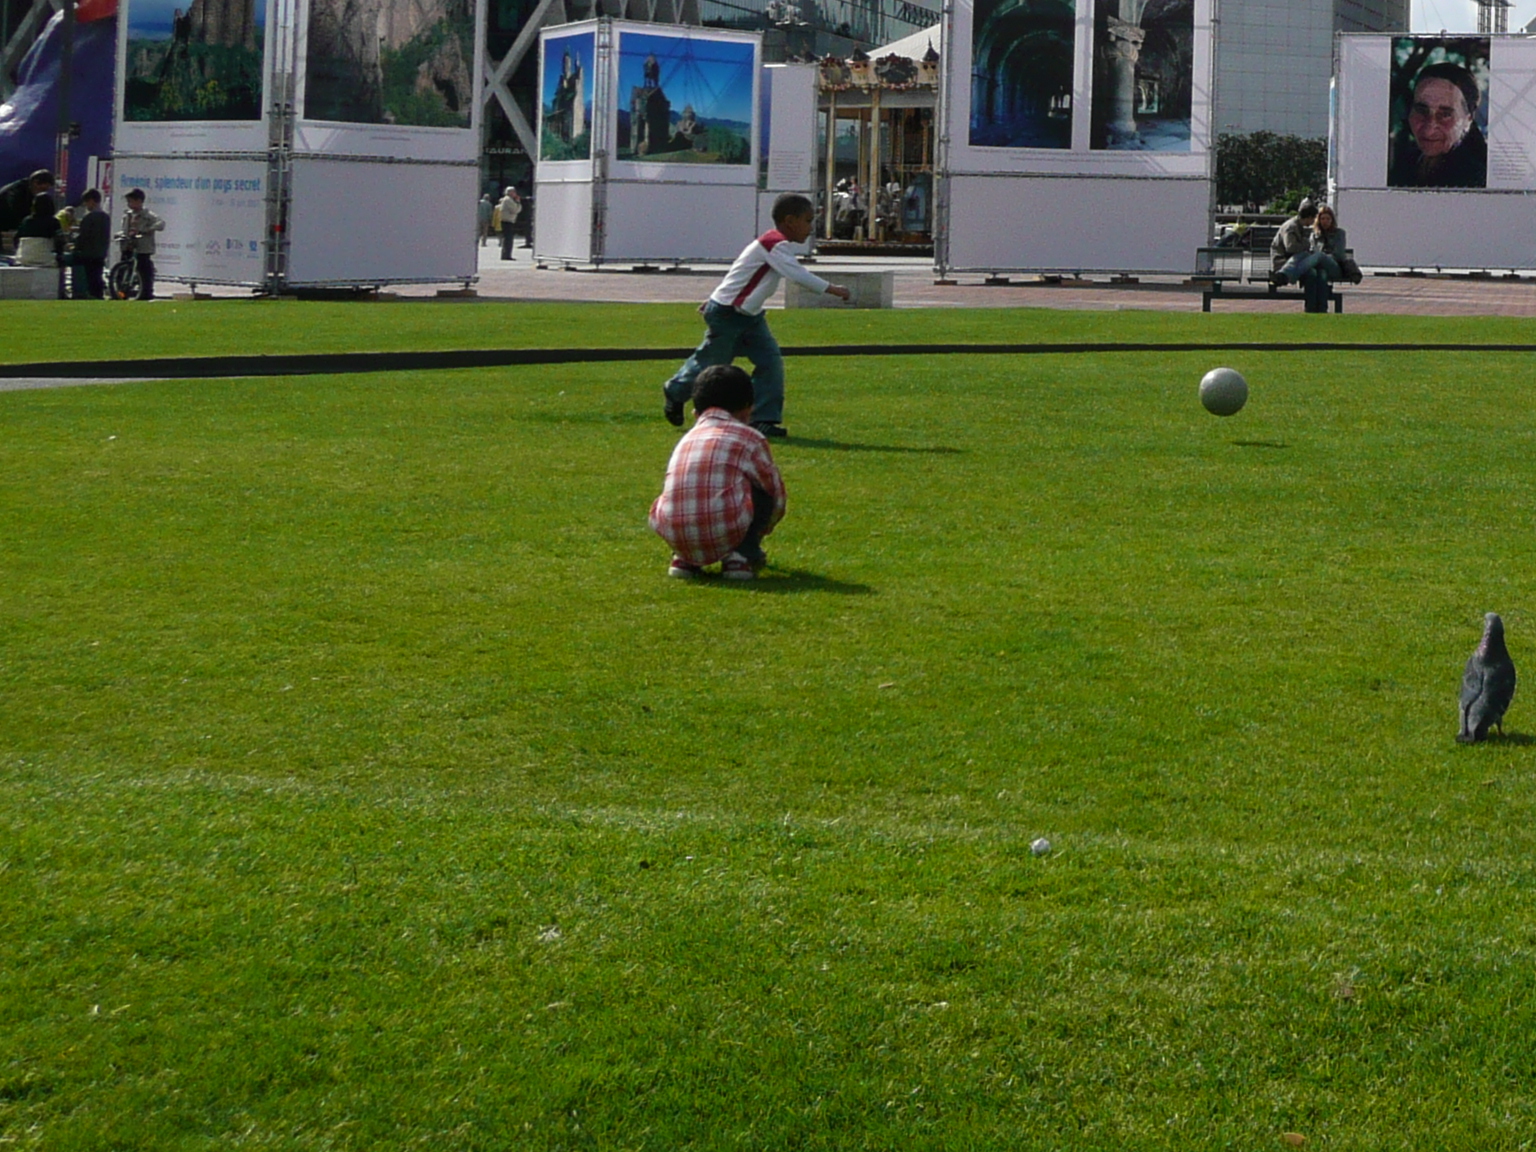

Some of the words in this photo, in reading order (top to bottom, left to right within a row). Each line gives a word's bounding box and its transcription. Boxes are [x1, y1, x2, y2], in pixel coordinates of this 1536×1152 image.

[155, 175, 193, 191] splendeur
[213, 178, 232, 193] pays
[234, 177, 261, 191] secret
